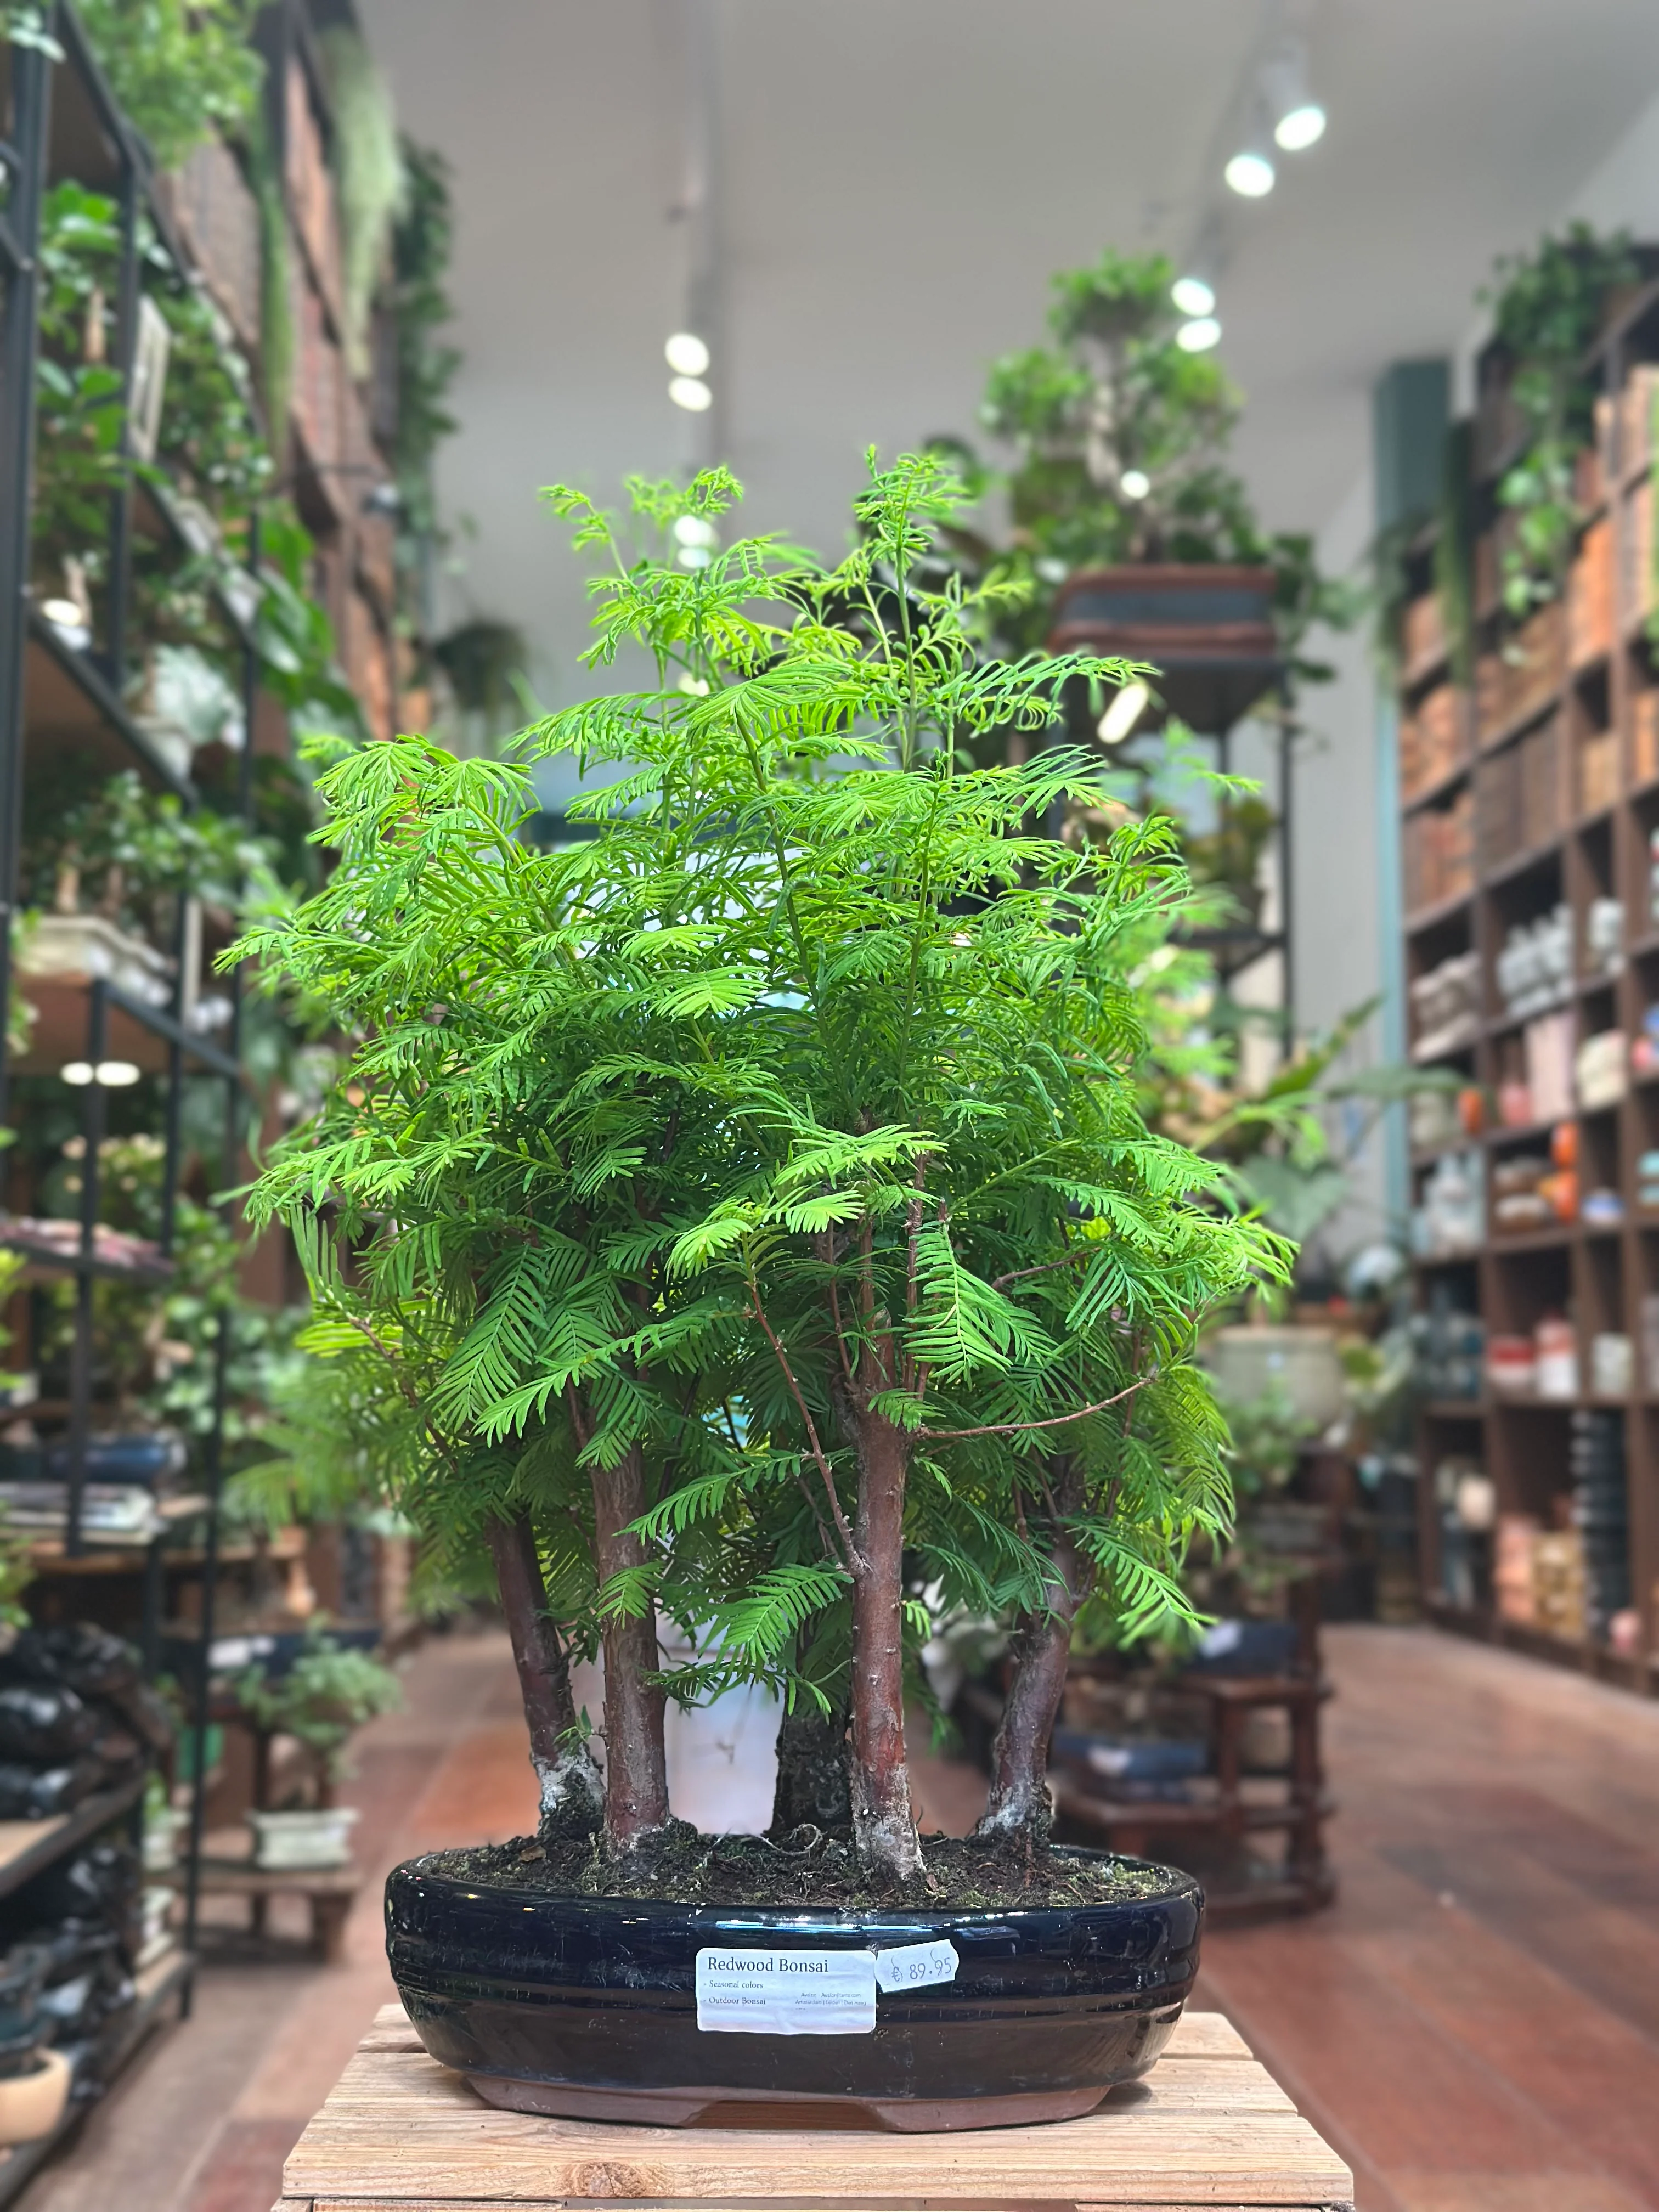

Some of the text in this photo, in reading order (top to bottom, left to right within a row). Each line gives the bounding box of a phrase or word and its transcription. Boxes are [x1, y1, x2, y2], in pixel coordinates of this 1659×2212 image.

[708, 1956, 828, 1972] Redwood Bonsai
[910, 1957, 952, 1980] 89.95
